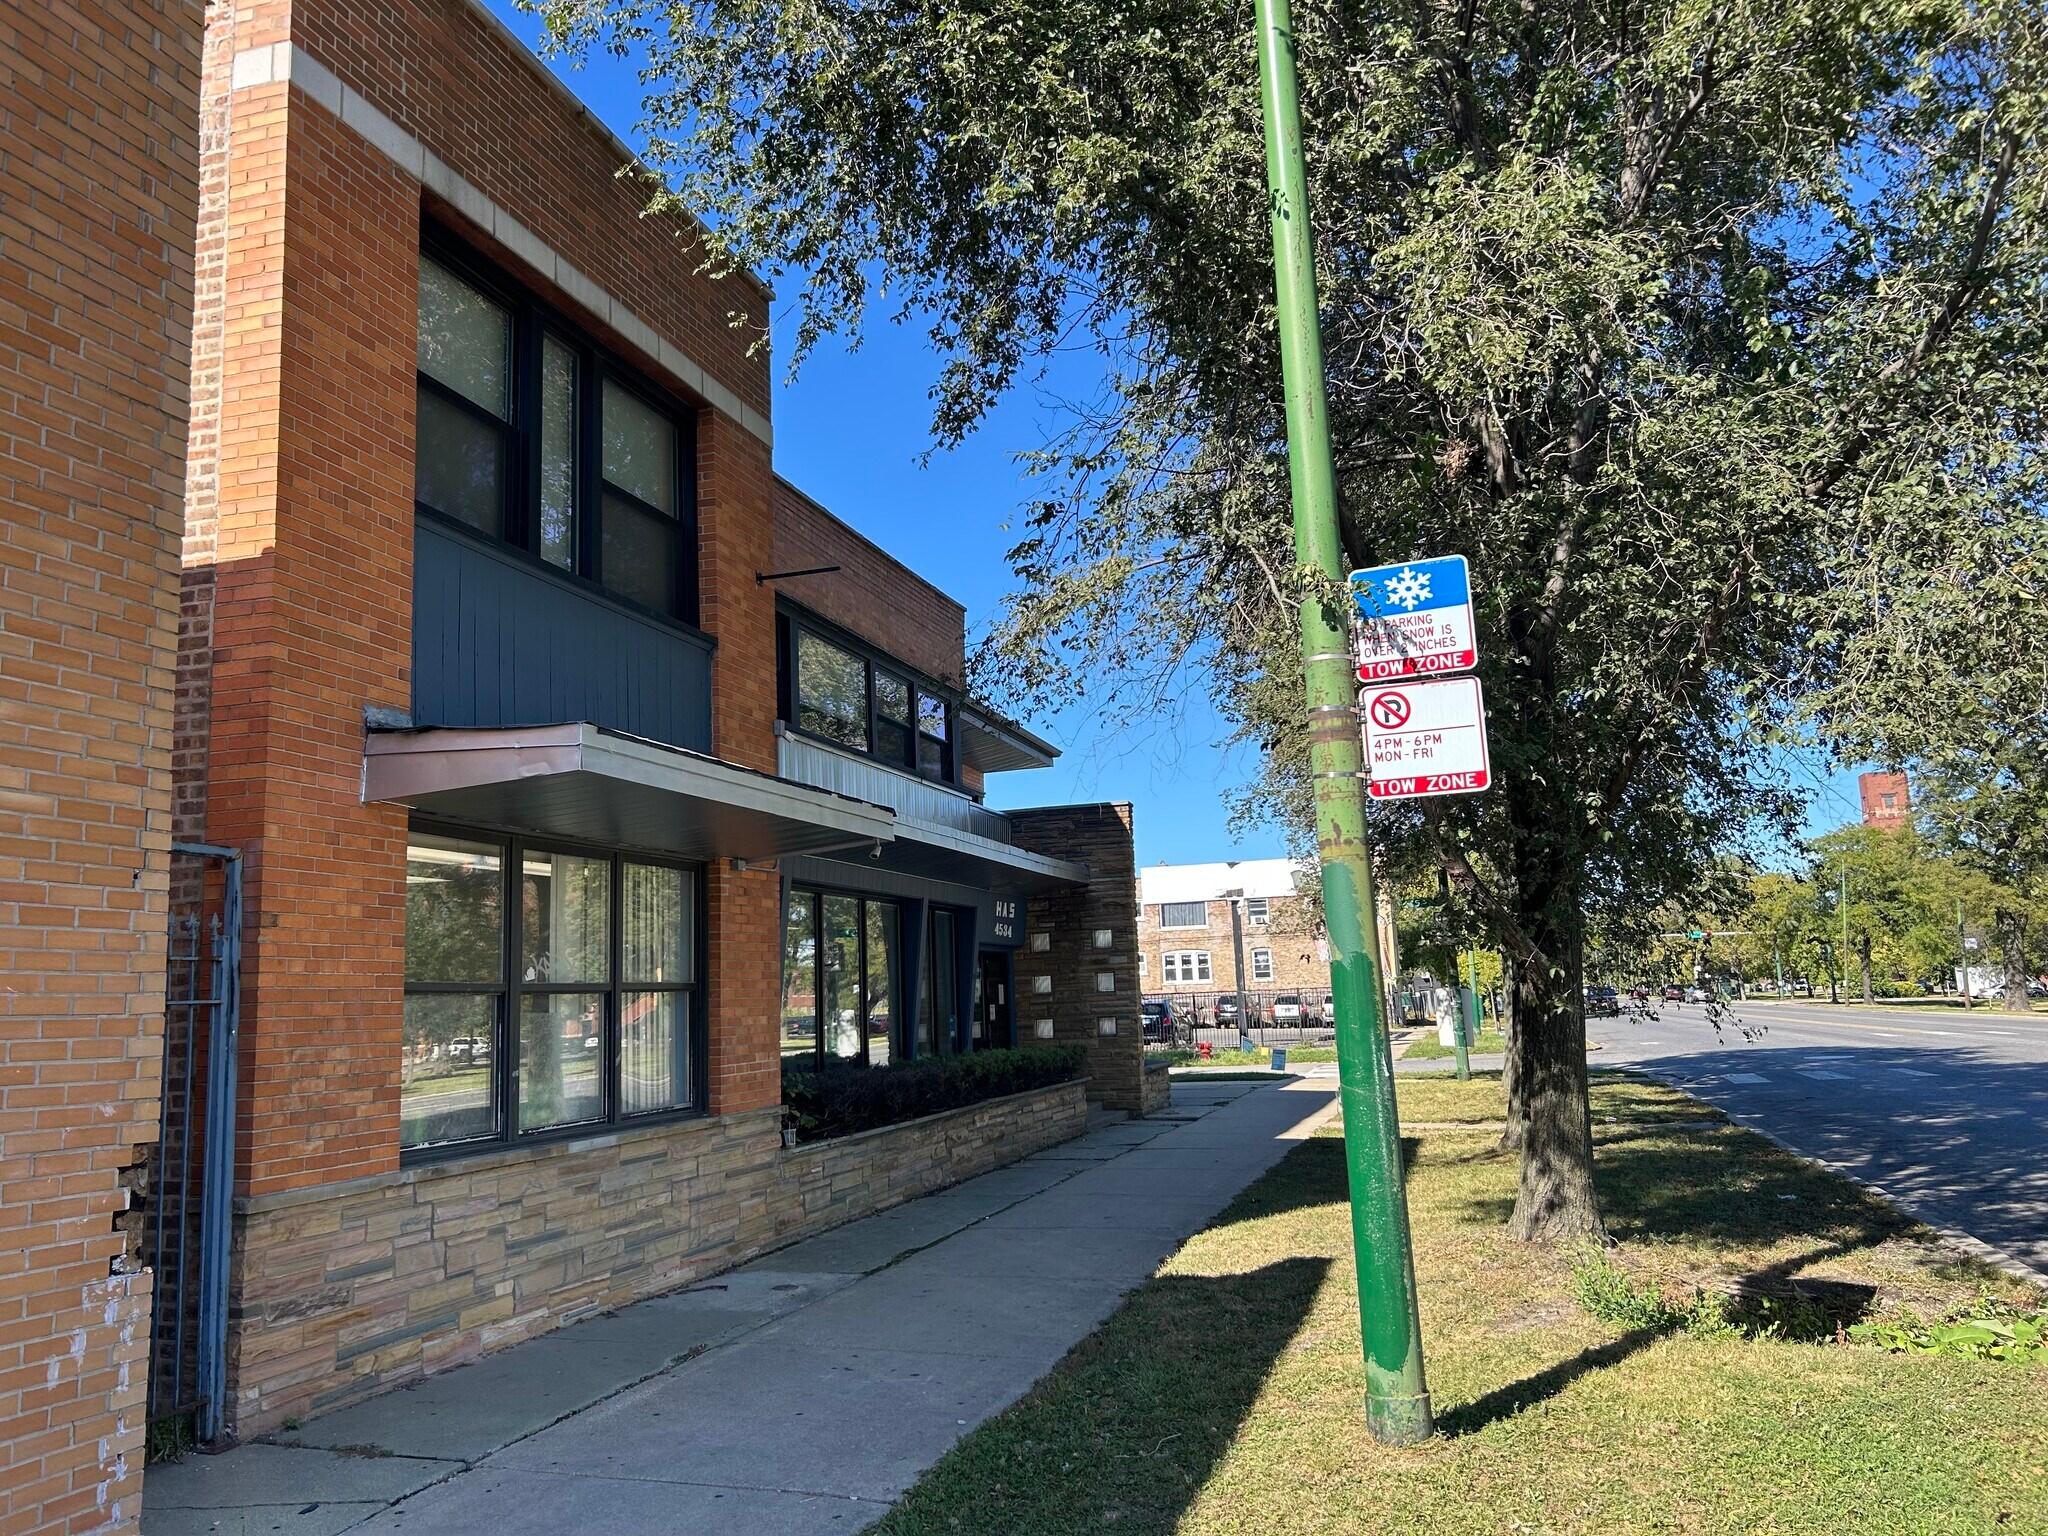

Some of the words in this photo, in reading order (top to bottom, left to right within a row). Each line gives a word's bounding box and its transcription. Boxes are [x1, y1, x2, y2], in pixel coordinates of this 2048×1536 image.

[1384, 614, 1433, 630] PARKING
[1364, 631, 1396, 645] WHEN
[1402, 626, 1434, 641] SNOW
[1441, 624, 1452, 635] IS
[1364, 645, 1394, 658] OVER
[1401, 643, 1408, 654] 2
[1415, 636, 1457, 651] INCHES
[1365, 658, 1404, 678] TOW
[1415, 653, 1465, 672] ZONE
[1375, 747, 1434, 763] MON-FRI
[1376, 778, 1416, 795] TOW
[1426, 772, 1478, 791] ZONE
[996, 901, 1015, 918] HAS
